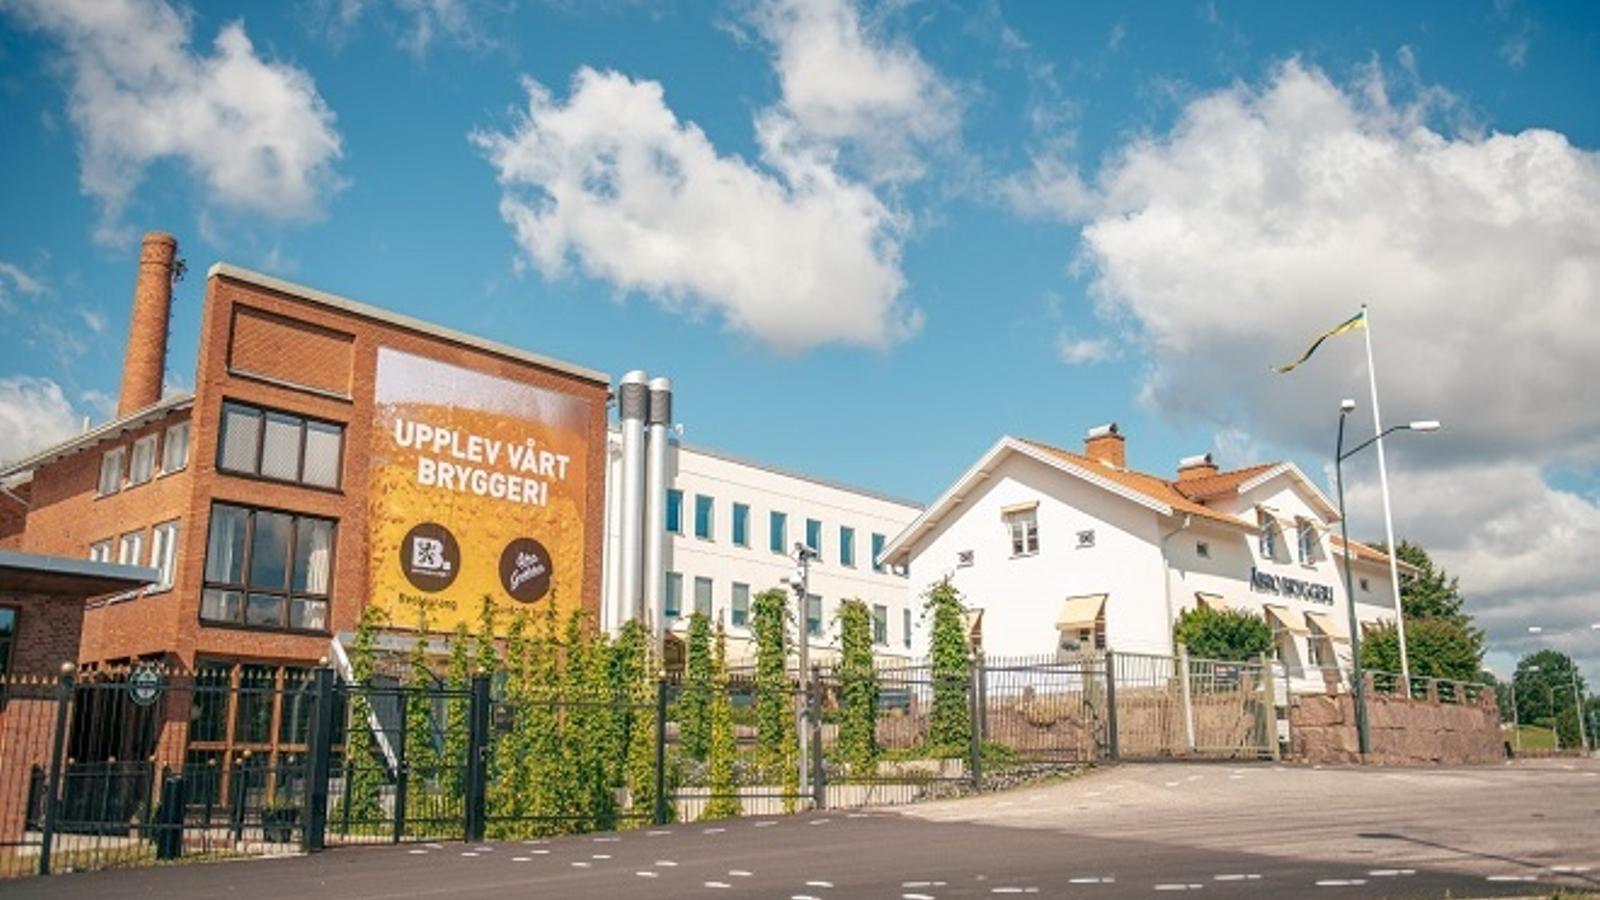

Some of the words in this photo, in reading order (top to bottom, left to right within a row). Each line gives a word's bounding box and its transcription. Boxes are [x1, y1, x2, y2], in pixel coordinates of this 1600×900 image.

[395, 418, 501, 465] UPPLEV
[507, 438, 570, 480] VÅRT
[418, 456, 548, 507] BRYGGERI
